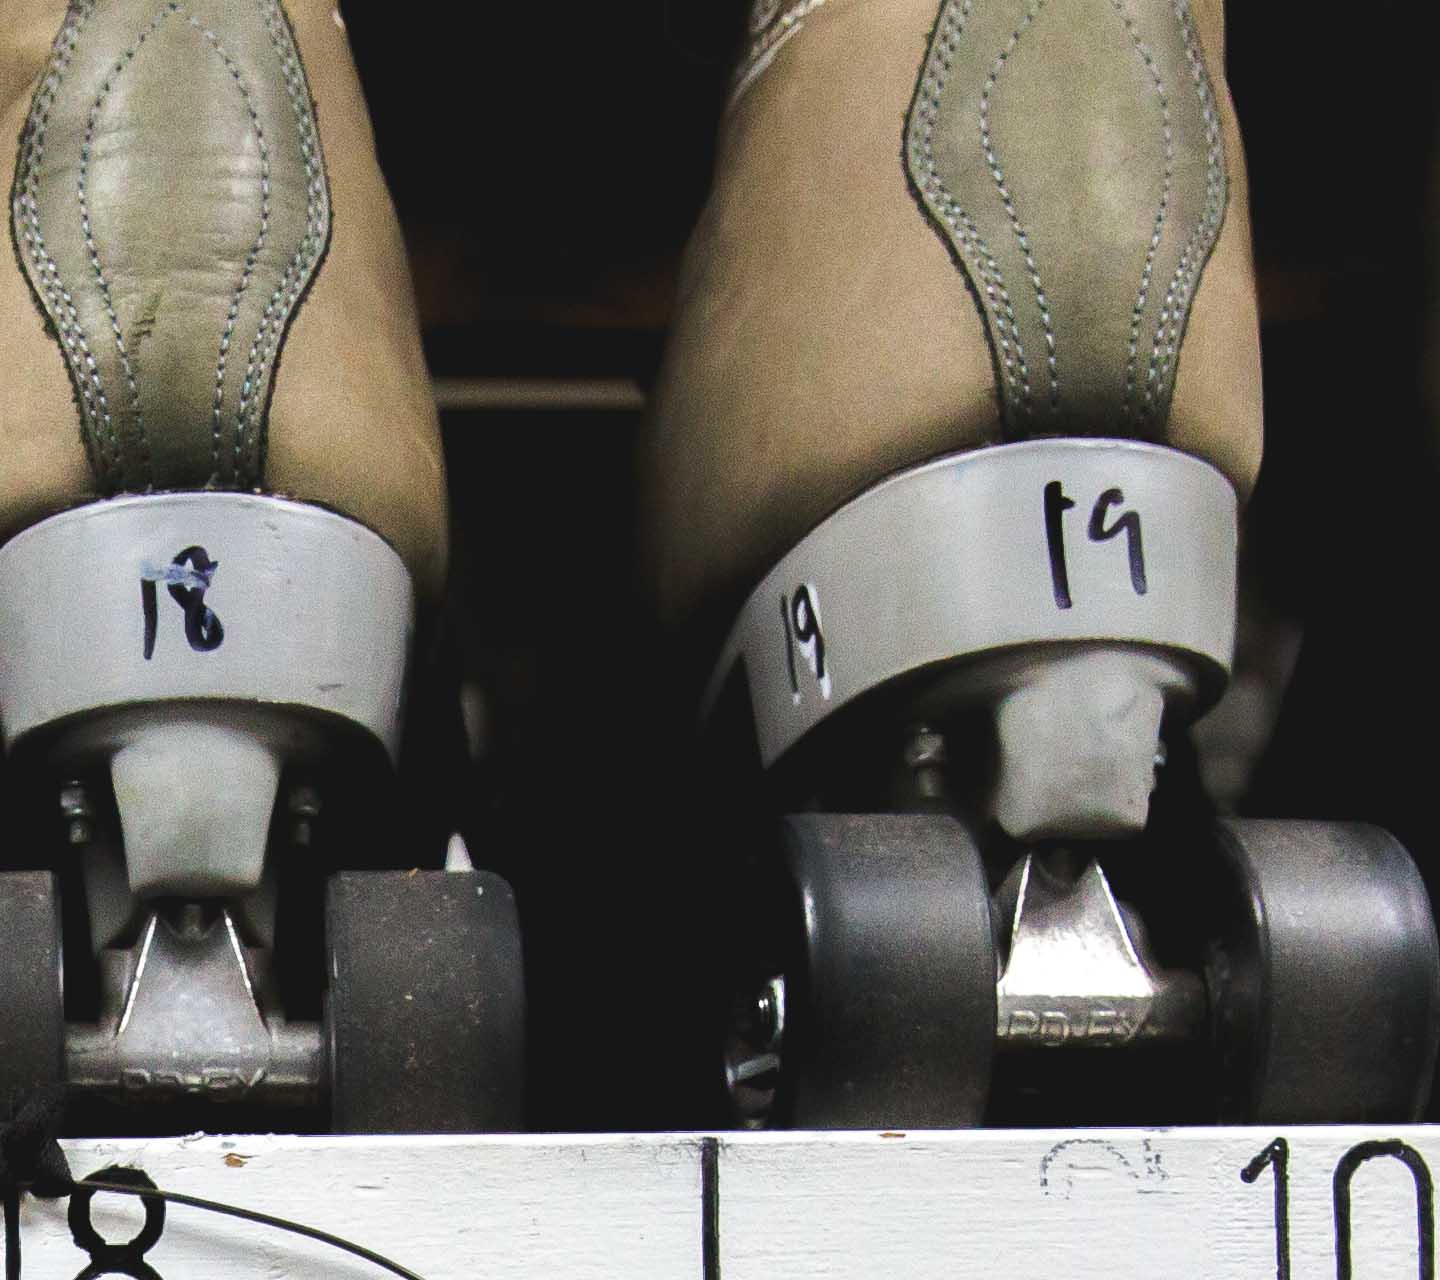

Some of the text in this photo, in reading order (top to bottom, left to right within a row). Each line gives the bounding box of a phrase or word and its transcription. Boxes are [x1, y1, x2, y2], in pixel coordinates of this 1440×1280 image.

[140, 545, 225, 660] 18
[1043, 480, 1147, 610] 19
[780, 584, 831, 702] 19
